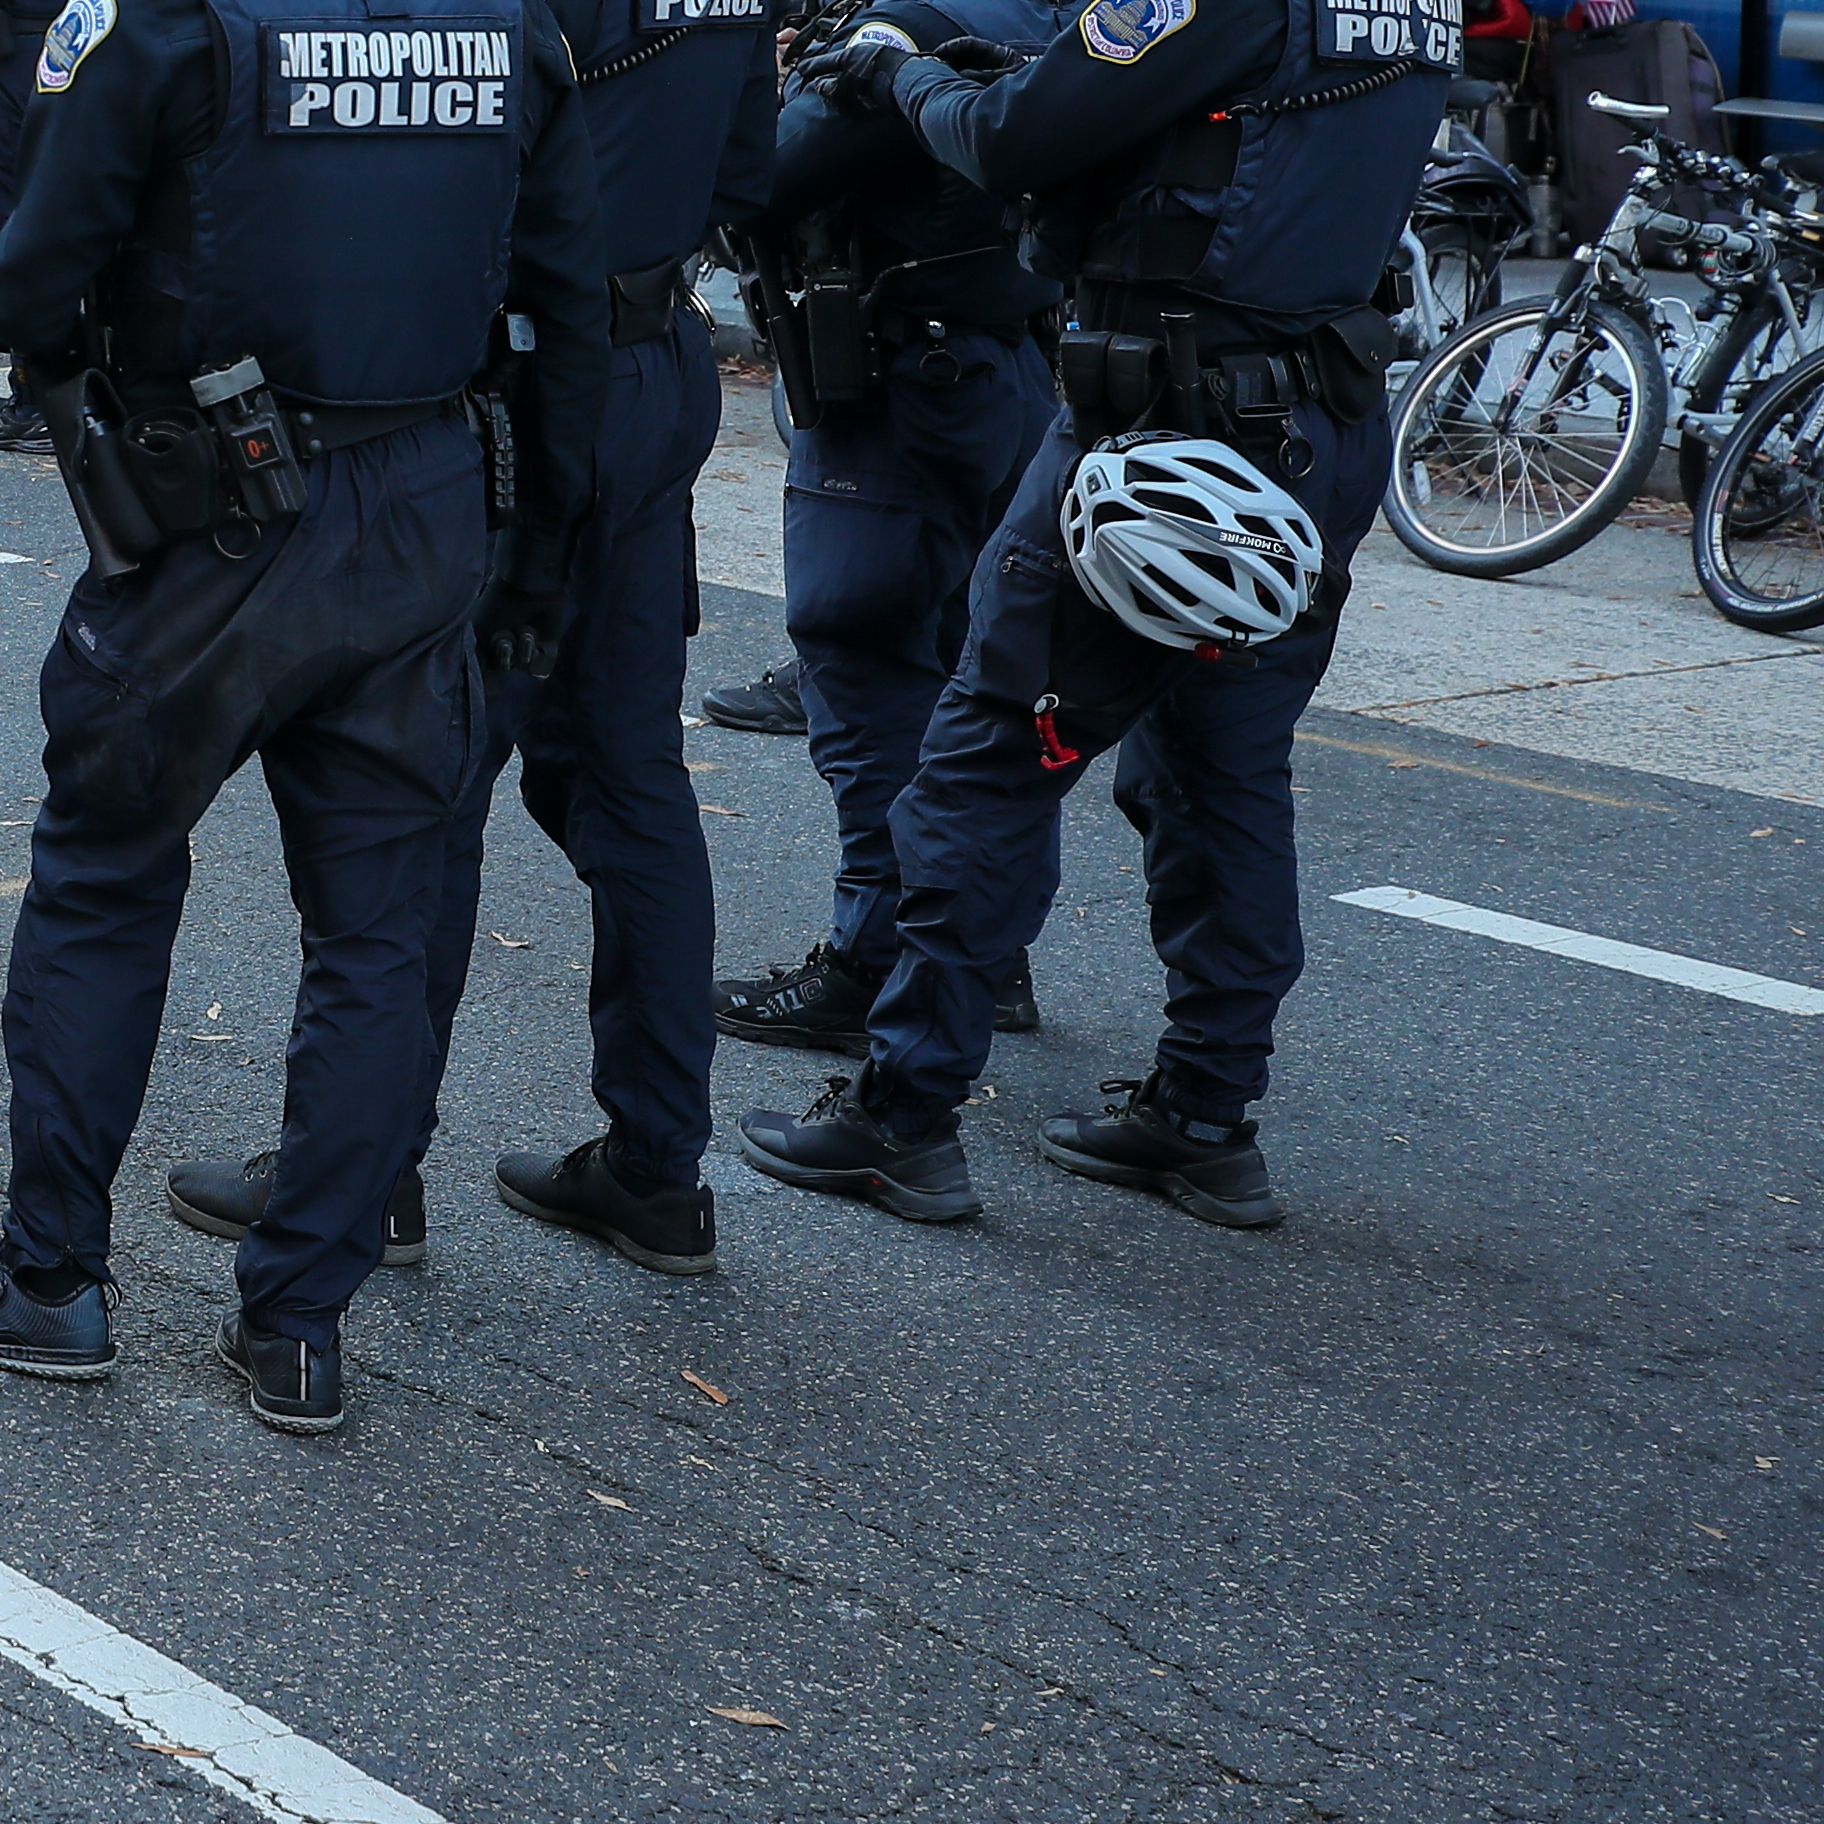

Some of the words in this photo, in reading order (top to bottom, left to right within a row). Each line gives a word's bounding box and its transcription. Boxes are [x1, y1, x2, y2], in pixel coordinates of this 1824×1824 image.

[279, 30, 510, 78] METROPOLITAN
[1336, 13, 1462, 66] POLCE
[290, 81, 505, 127] POLICE
[1219, 531, 1272, 550] MOKFIRE
